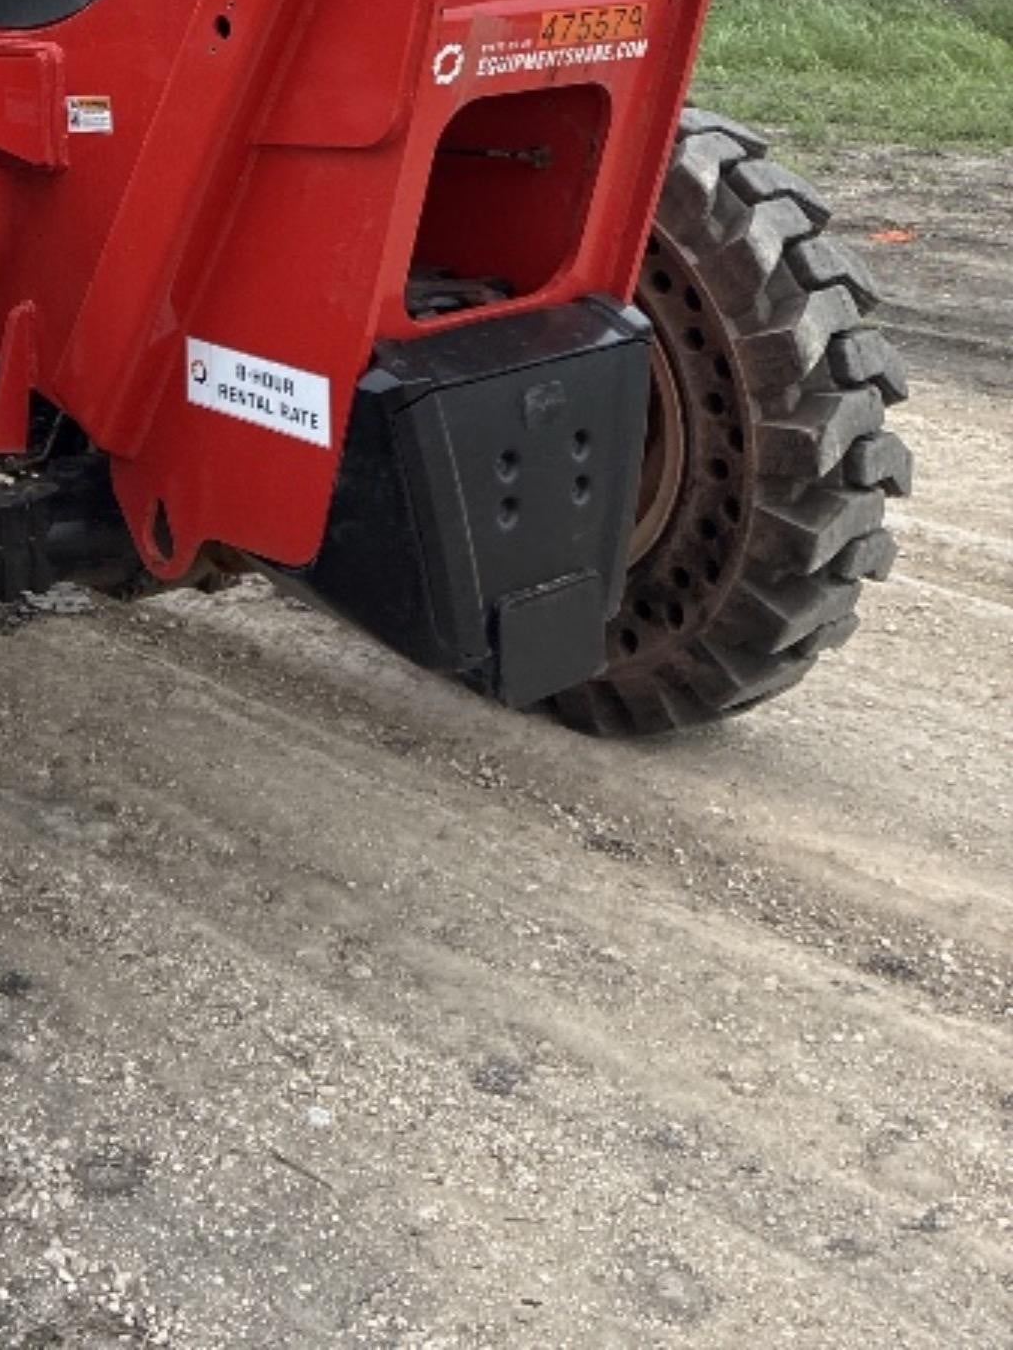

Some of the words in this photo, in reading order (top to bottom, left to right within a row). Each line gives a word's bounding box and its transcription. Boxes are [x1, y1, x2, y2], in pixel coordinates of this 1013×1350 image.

[541, 4, 644, 46] 475579
[475, 38, 649, 77] EQUIPMENTSHARE.COM
[217, 383, 274, 416] RENTAL
[279, 400, 320, 430] RATE
